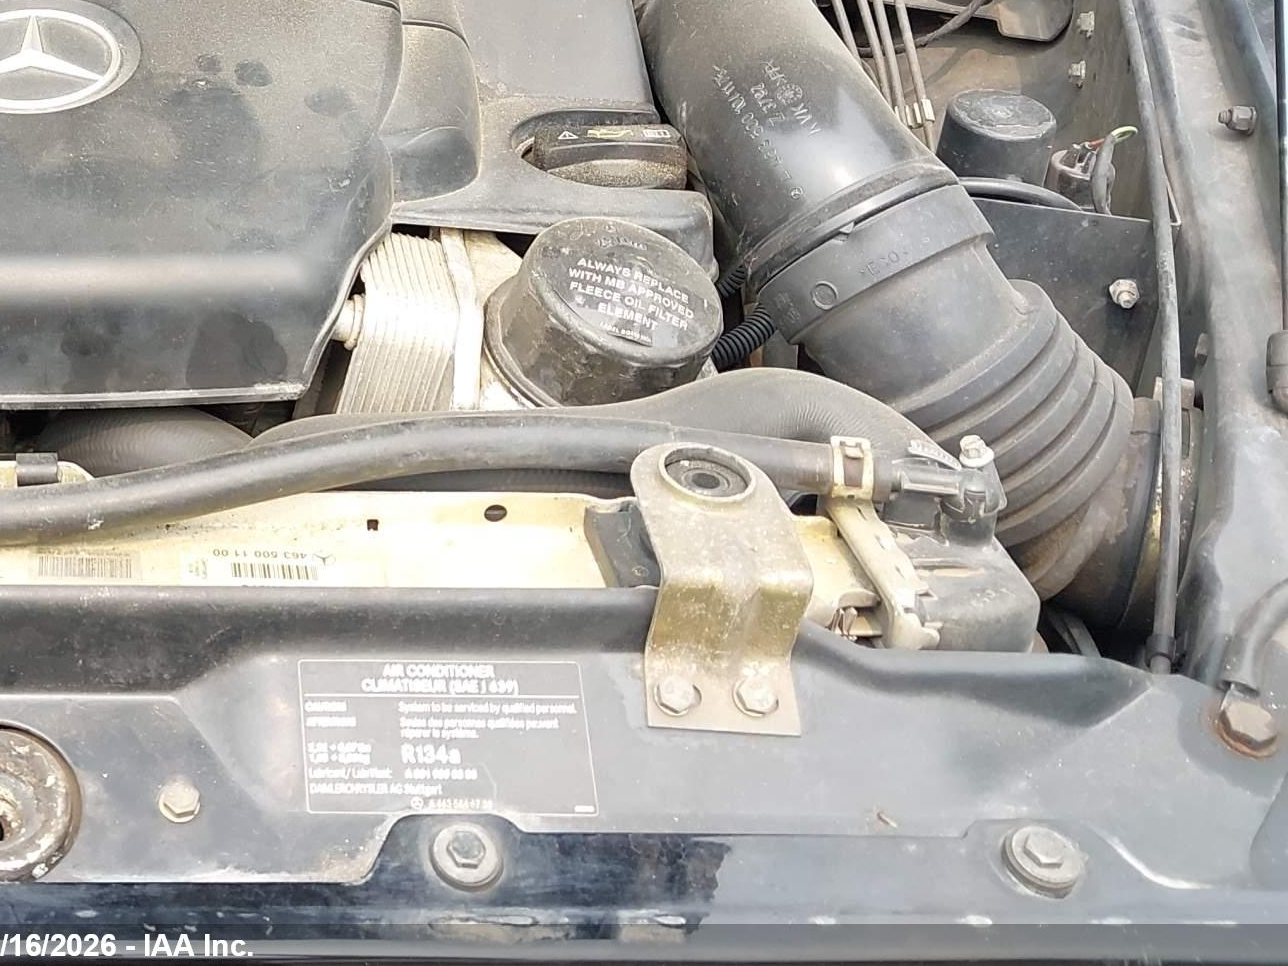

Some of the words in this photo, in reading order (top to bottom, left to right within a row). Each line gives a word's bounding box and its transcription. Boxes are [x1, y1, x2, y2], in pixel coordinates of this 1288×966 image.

[577, 257, 631, 278] ALWAYS
[633, 270, 689, 304] REPLACE
[568, 267, 602, 284] WITH
[605, 276, 626, 290] MB
[627, 280, 695, 320] APPROVED
[569, 281, 622, 302] FLEECE
[624, 296, 645, 310] OIL
[648, 304, 689, 331] FILTER
[598, 302, 658, 331] ELEMENT
[212, 548, 229, 557] 00
[233, 550, 249, 558] 11
[253, 550, 279, 559] 500
[283, 552, 308, 560] 463
[382, 664, 405, 678] AIR
[406, 664, 496, 679] CONDITIONER
[432, 702, 441, 713] to
[490, 702, 501, 714] by
[400, 744, 461, 764] R134a
